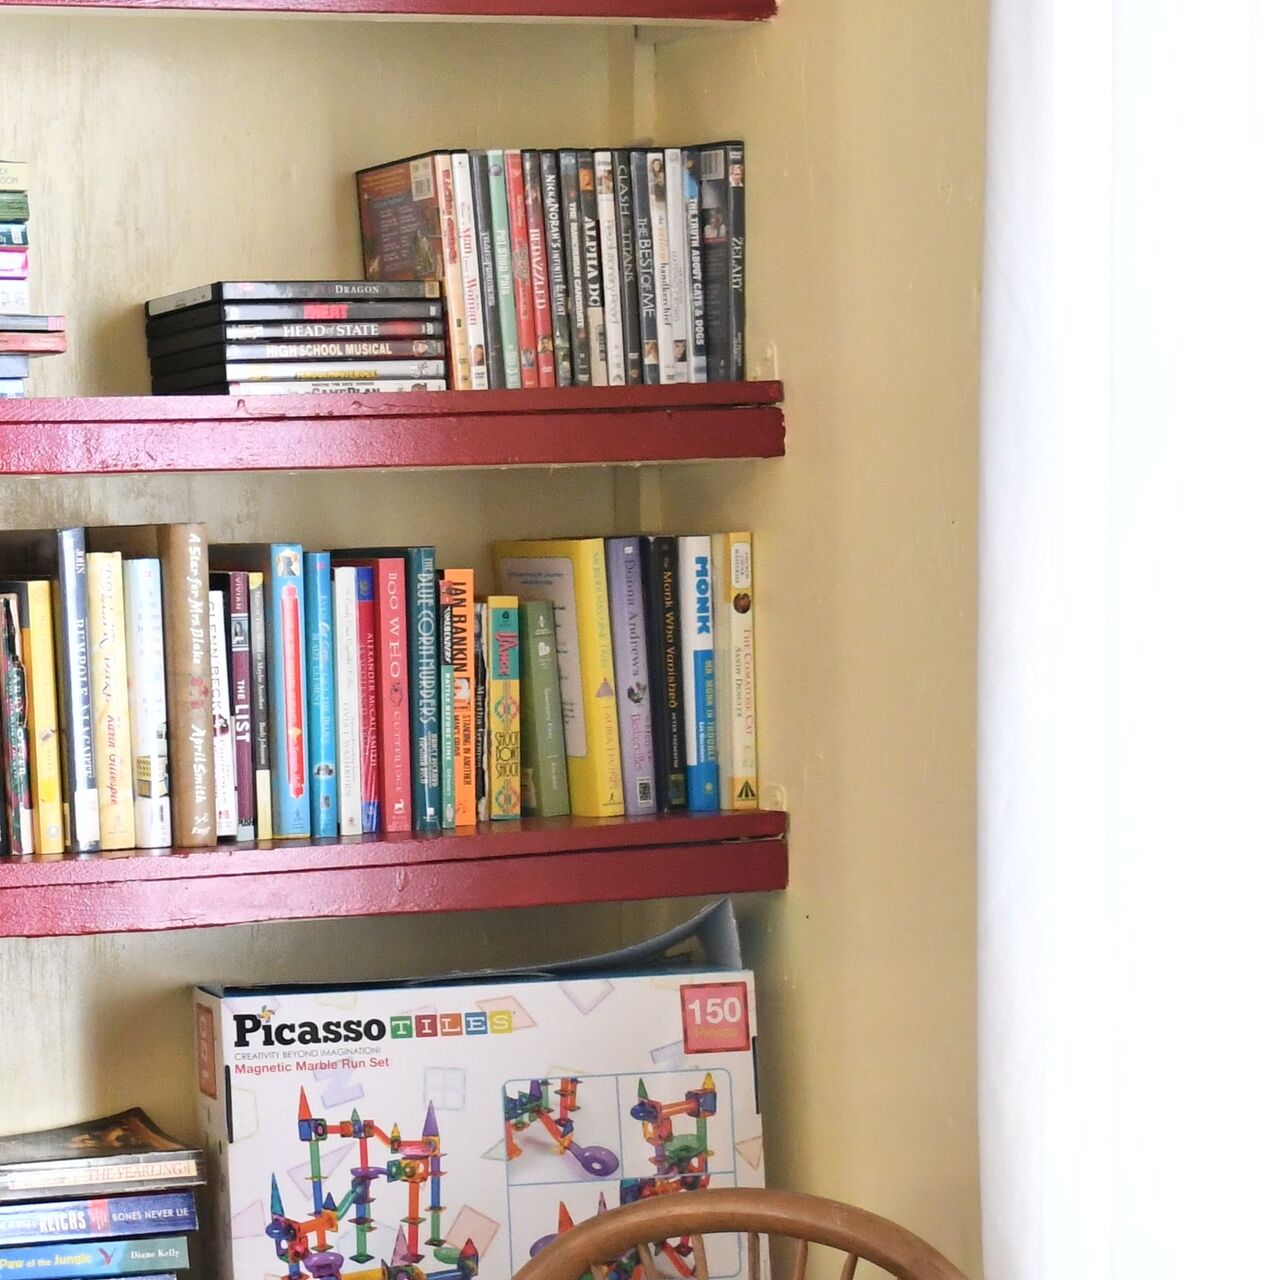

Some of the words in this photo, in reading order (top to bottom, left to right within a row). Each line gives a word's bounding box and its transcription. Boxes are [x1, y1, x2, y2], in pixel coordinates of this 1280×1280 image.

[638, 217, 648, 237] THE
[584, 216, 599, 279] ALPHA
[639, 240, 651, 273] BEST
[530, 229, 546, 309] BEDAZZLED
[335, 285, 379, 294] DRAGON
[642, 275, 651, 291] OF
[643, 293, 655, 317] ME
[283, 325, 325, 337] HEAD
[337, 324, 378, 336] STATE
[266, 345, 297, 357] HIGH
[299, 345, 343, 356] SCHOOL
[345, 343, 392, 355] MUSICAL
[423, 558, 432, 571] THE
[417, 572, 433, 607] BLUE
[452, 582, 466, 606] IAN
[695, 557, 710, 634] MONK
[418, 610, 434, 658] CORN
[453, 614, 468, 672] RANKIN
[237, 680, 245, 699] THE
[419, 660, 435, 723] MURDERS
[236, 705, 249, 742] LIST
[688, 997, 741, 1024] 150
[233, 1013, 386, 1047] Picasso
[391, 1011, 512, 1038] TILES
[235, 1062, 291, 1076] Magnetic
[296, 1060, 337, 1071] Marble
[343, 1059, 365, 1070] Run
[369, 1057, 389, 1068] Set
